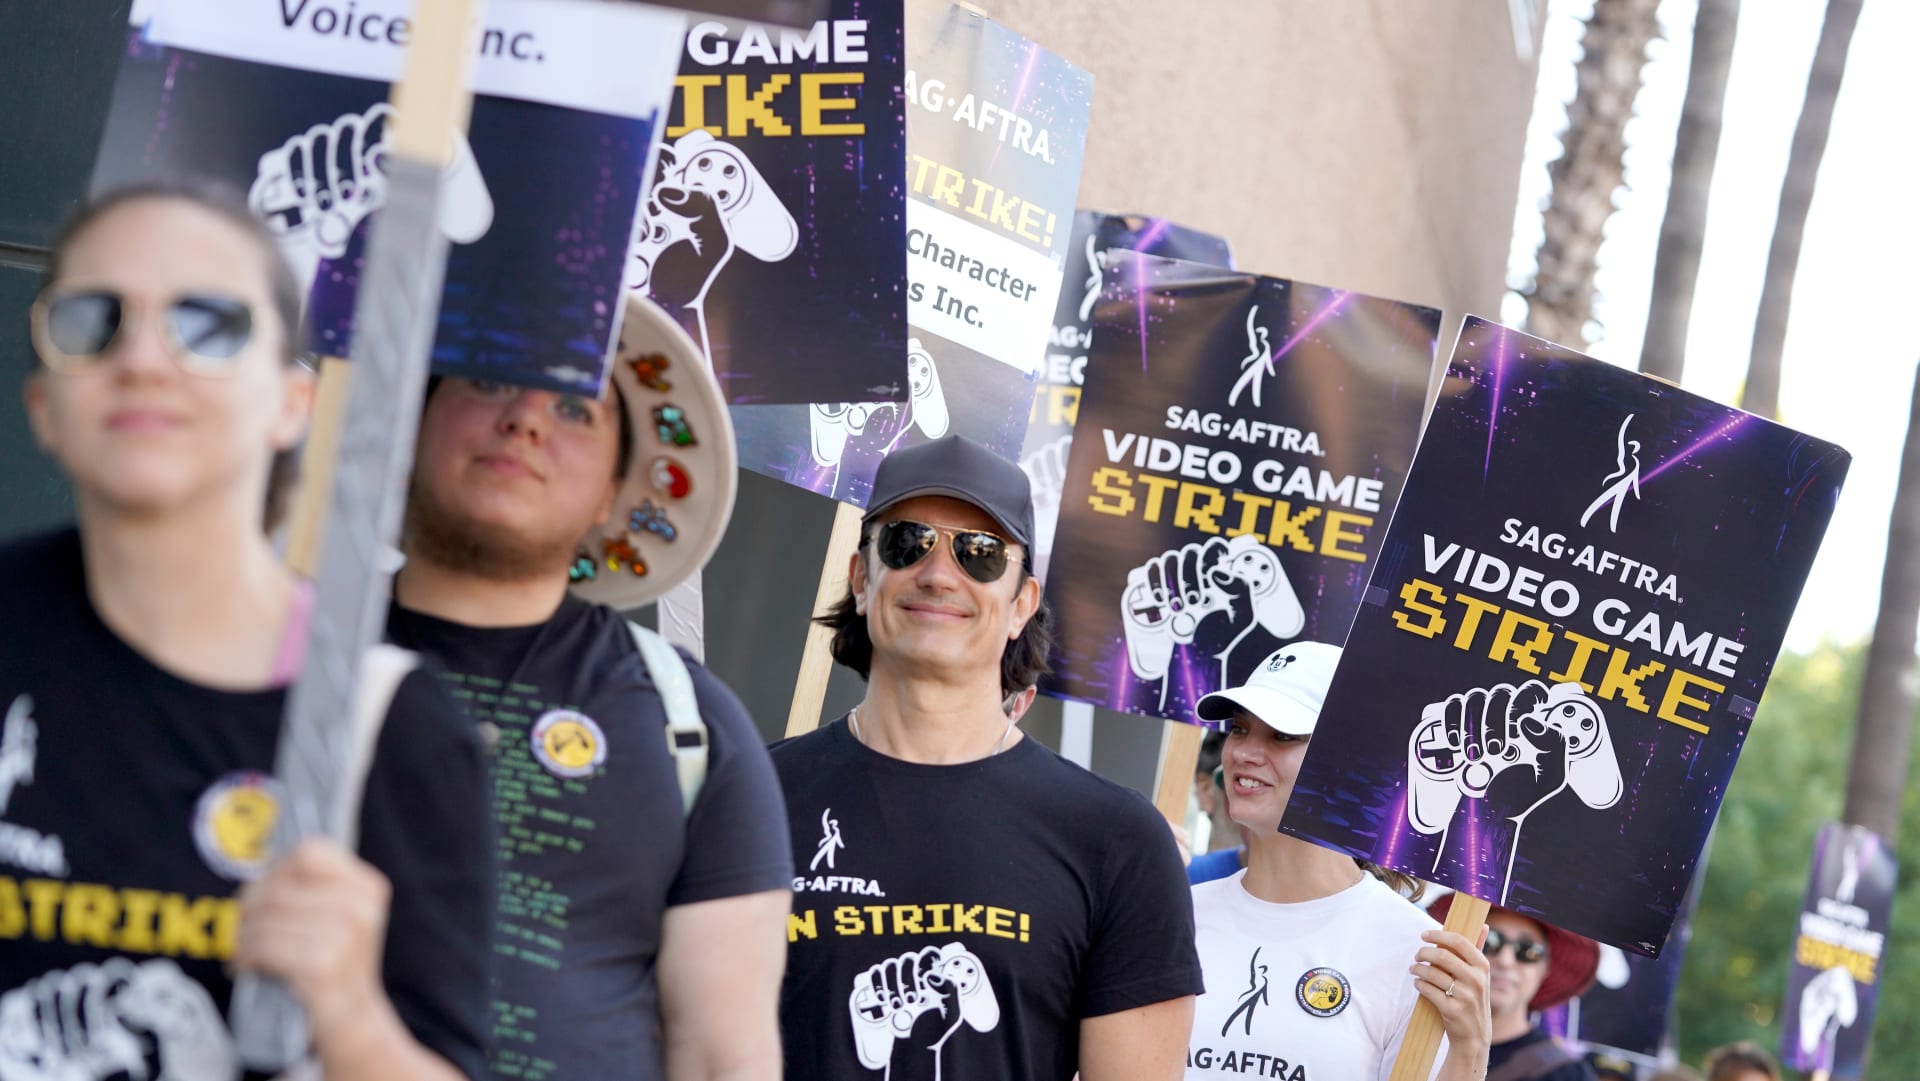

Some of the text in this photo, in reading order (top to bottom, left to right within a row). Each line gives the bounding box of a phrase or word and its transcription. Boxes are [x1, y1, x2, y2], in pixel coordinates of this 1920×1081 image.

[280, 0, 545, 61] Voice nc.
[687, 20, 869, 66] GAME
[667, 72, 866, 137] IKE
[905, 154, 1057, 247] TRIKE!
[906, 228, 1037, 302] Character
[932, 285, 984, 328] Inc.
[1102, 428, 1384, 512] VIDEO GAME
[1088, 467, 1374, 563] STRIKE
[1423, 533, 1745, 678] VIDEO GAME
[1391, 578, 1727, 735] STRIKE
[792, 876, 886, 897] G·AFTRA
[787, 903, 1030, 942] N STRIKE!
[1187, 1047, 1307, 1081] G·AFTRA
